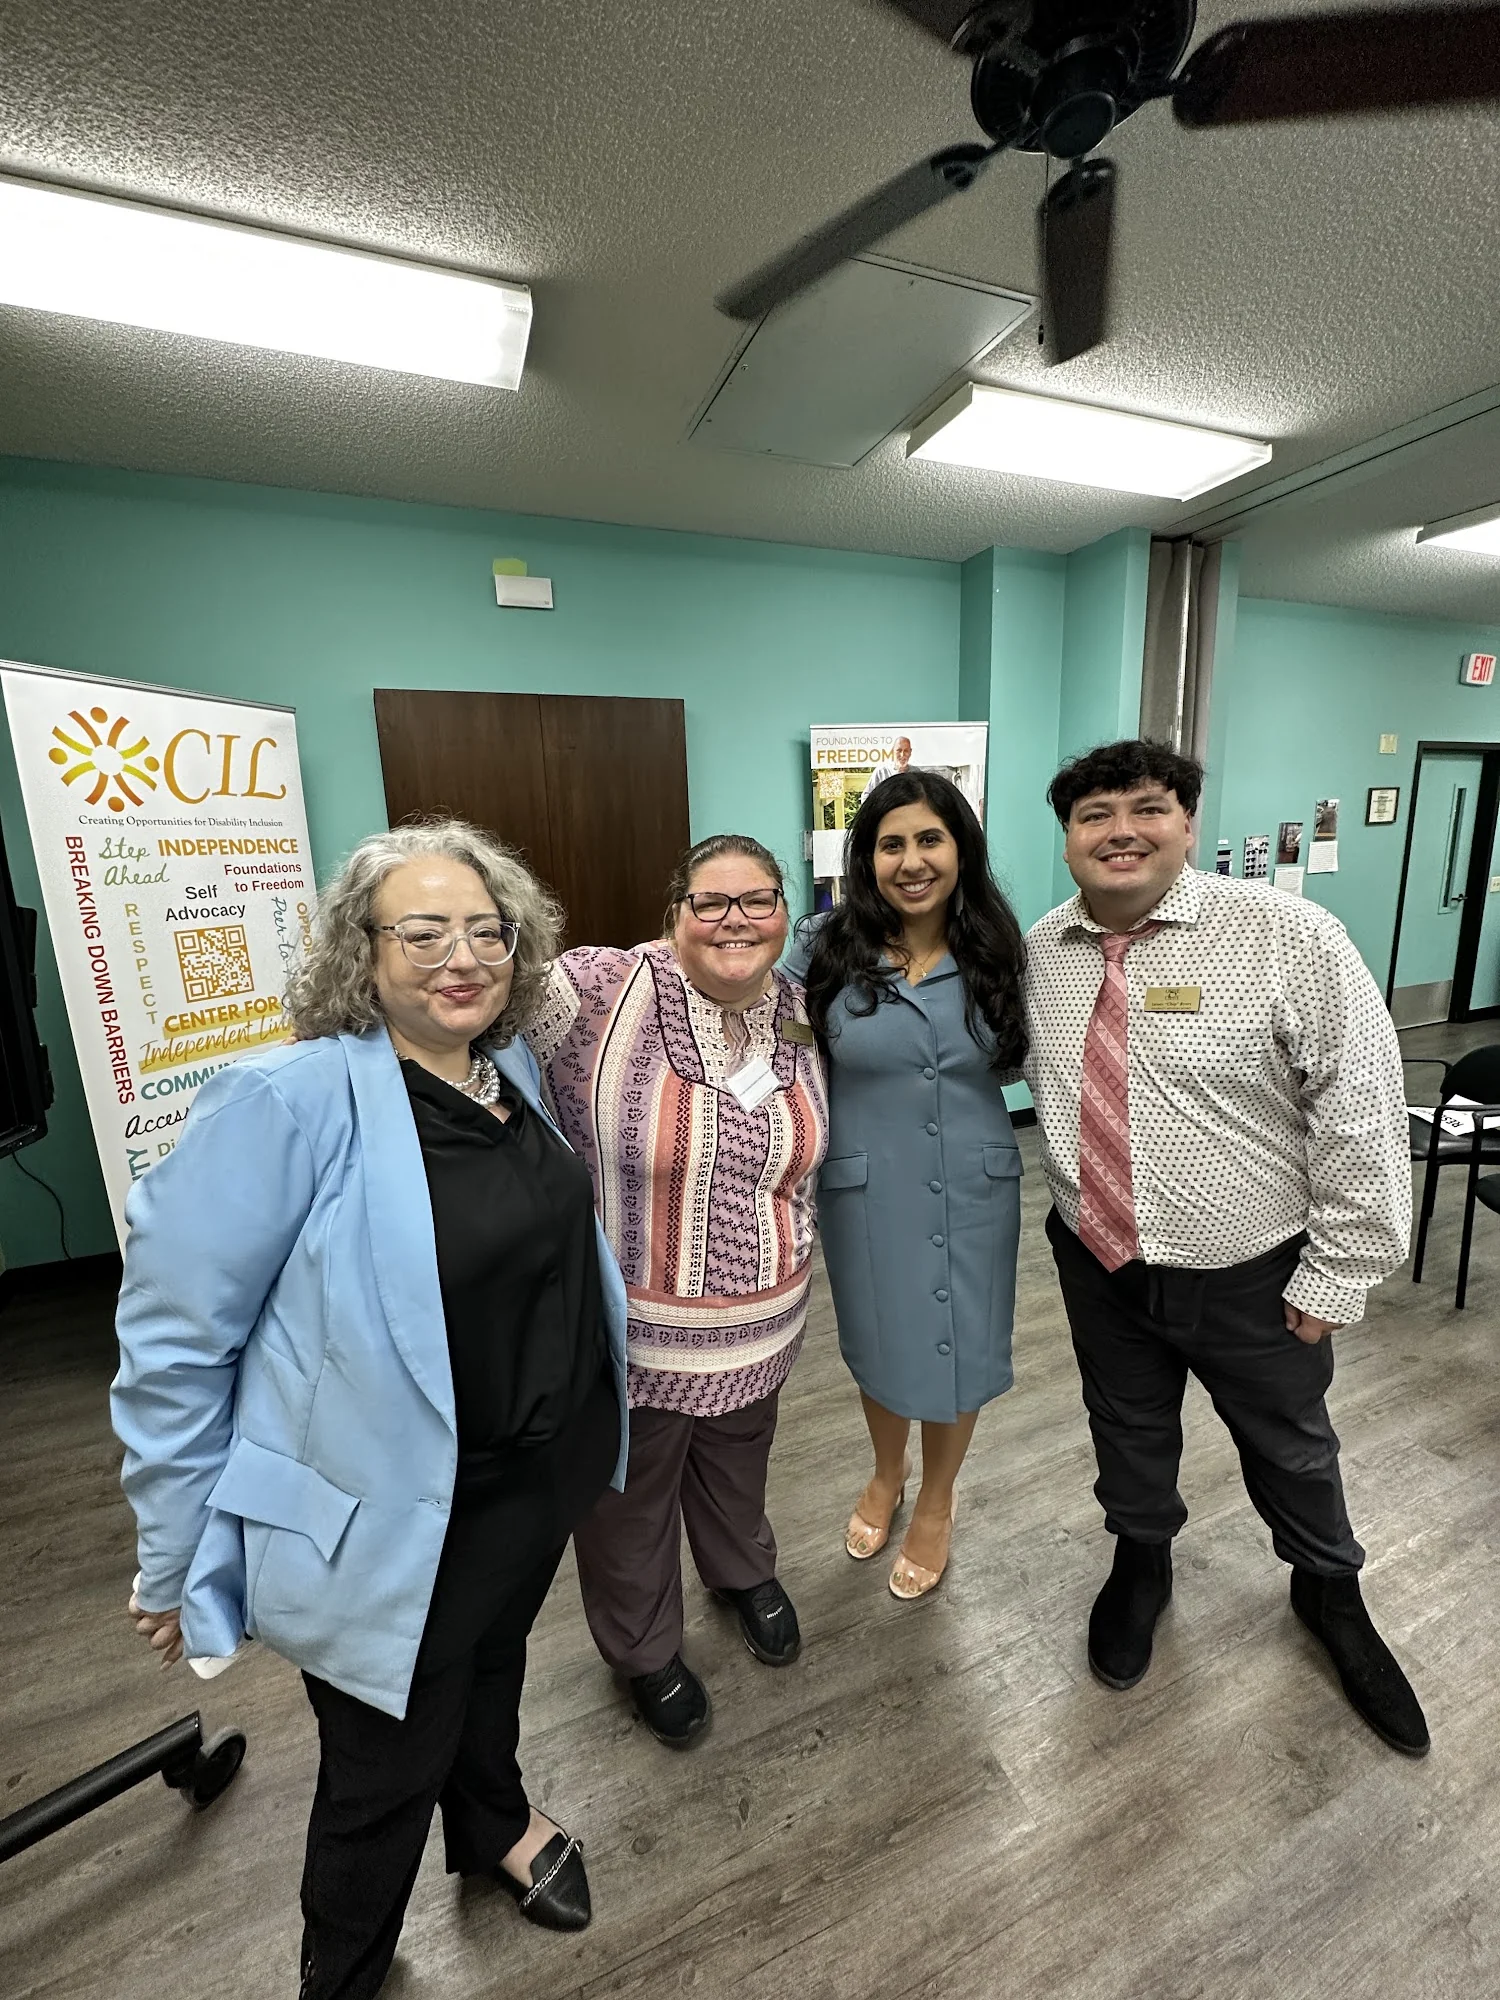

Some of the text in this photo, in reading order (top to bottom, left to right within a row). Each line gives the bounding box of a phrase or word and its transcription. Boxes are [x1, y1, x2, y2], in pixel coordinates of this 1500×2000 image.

[1472, 655, 1494, 681] EXIT
[816, 736, 893, 746] FOUNDATIONS TO
[163, 729, 287, 804] CIL
[817, 748, 895, 764] FREEDOM
[78, 814, 283, 828] Creating Opportunities for Disability Inclusion
[98, 836, 151, 862] Step
[157, 838, 299, 857] INDEPENDENCE
[104, 862, 170, 886] Ahead
[224, 862, 302, 876] Foundations
[185, 884, 218, 900] Self
[234, 878, 304, 893] to Freedom
[165, 904, 246, 922] Advocacy
[65, 836, 135, 1105] BREAKING DOWN BARRIERS
[125, 903, 158, 1025] RESPECT
[164, 996, 280, 1032] CENTER FOR
[140, 1020, 253, 1071] Independent
